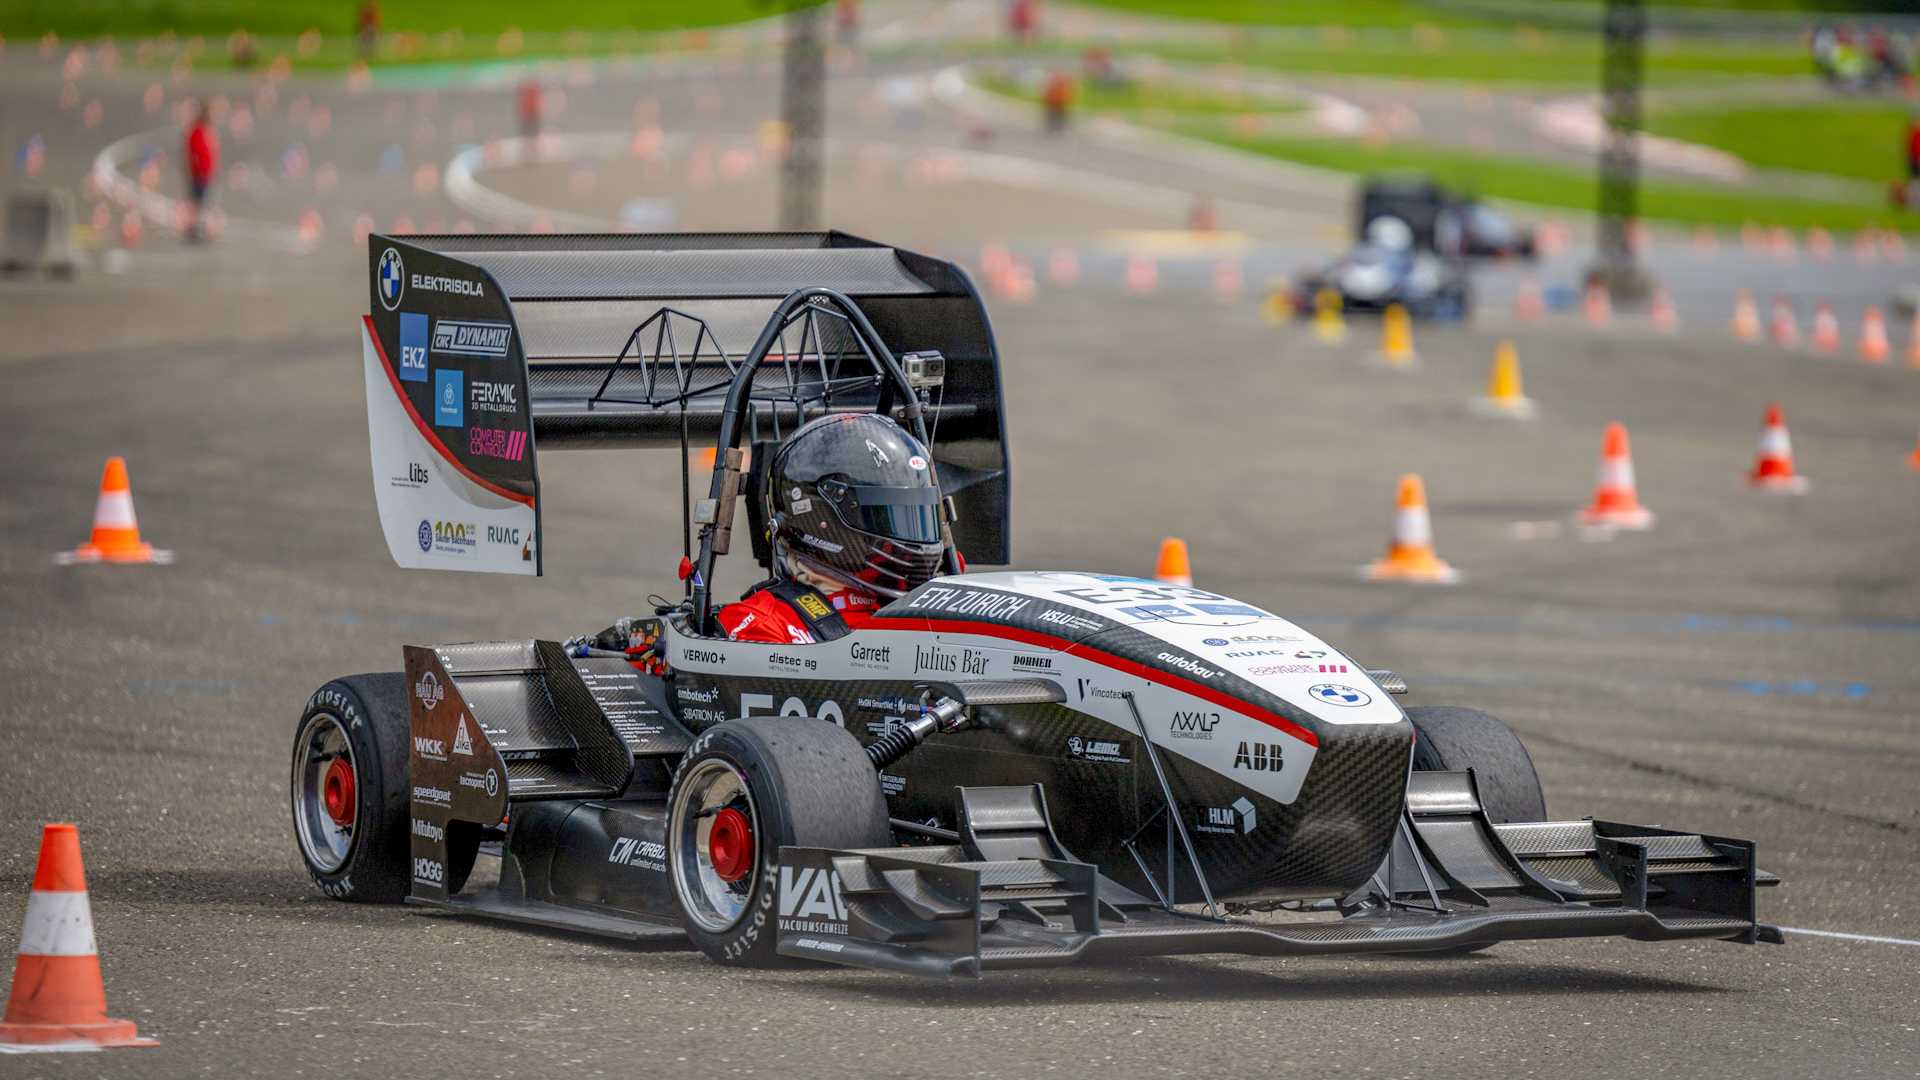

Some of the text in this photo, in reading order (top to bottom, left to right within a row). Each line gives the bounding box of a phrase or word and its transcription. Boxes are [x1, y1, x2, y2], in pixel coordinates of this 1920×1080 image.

[411, 274, 484, 297] ELEKTRISOLA
[457, 326, 508, 347] DYNAMIX
[402, 346, 425, 368] EKZ
[471, 381, 517, 404] FERAMIC
[480, 403, 516, 413] METALLDRUCK
[470, 427, 506, 443] COMPUTER
[409, 462, 429, 484] libs
[487, 526, 519, 545] RUAG
[800, 594, 828, 617] OMP
[908, 587, 952, 610] ETH
[1038, 609, 1075, 625] HSLU
[769, 652, 801, 666] distec
[804, 657, 817, 670] ag
[851, 641, 890, 663] Garrett
[913, 645, 990, 675] Julius Bär
[1157, 652, 1215, 678] autobau
[683, 707, 725, 722] SIBATRON AG
[1170, 711, 1220, 732] AXALP
[414, 736, 443, 755] WKK
[1171, 730, 1213, 740] TECHNOLOGIES
[1233, 741, 1284, 772] ABB
[413, 786, 451, 801] speedgoat
[1208, 807, 1234, 825] HLM
[412, 818, 443, 842] Mitutoyo
[608, 836, 665, 865] CM CARBO
[778, 919, 849, 935] VACUUMSCHMELZE
